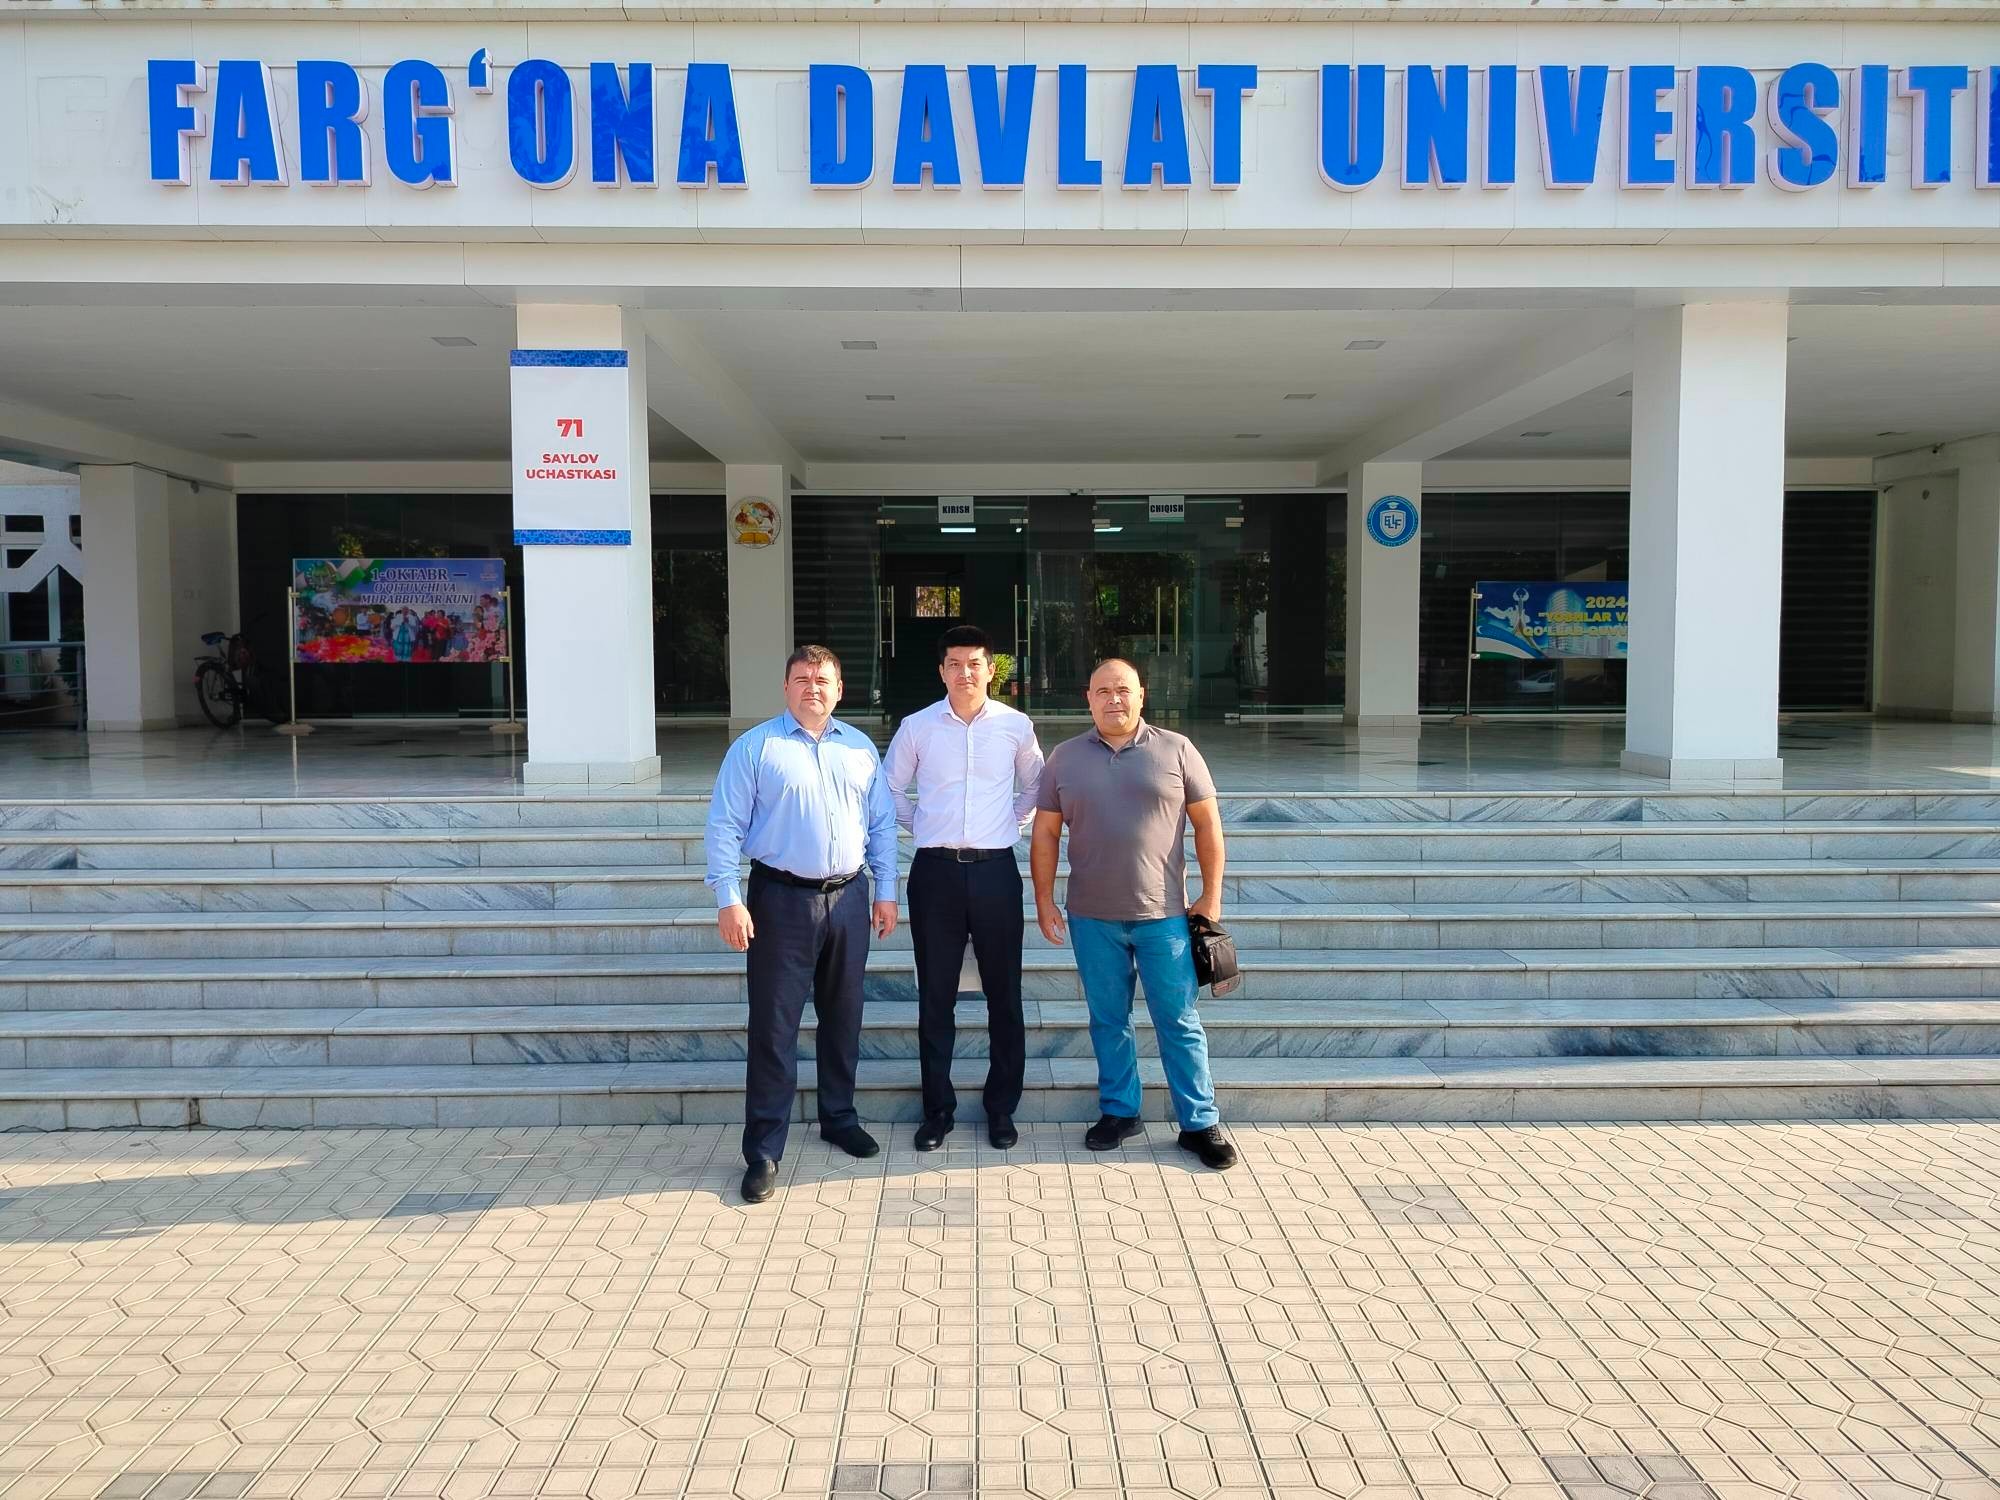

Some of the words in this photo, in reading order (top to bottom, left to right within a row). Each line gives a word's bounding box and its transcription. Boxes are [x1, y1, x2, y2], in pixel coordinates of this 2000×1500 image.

[147, 48, 747, 188] FARG‘ONA
[808, 64, 1259, 189] DAVLAT
[1318, 62, 2000, 191] UNIVERSIT
[556, 418, 583, 437] 71
[542, 453, 599, 464] SAYLOV
[526, 468, 616, 479] UCHASTKASI
[942, 505, 970, 514] KIRISH
[1150, 504, 1184, 513] CHIQISH
[370, 568, 449, 581] 1-OKTABR
[442, 582, 457, 593] VA
[444, 594, 473, 604] KUNI
